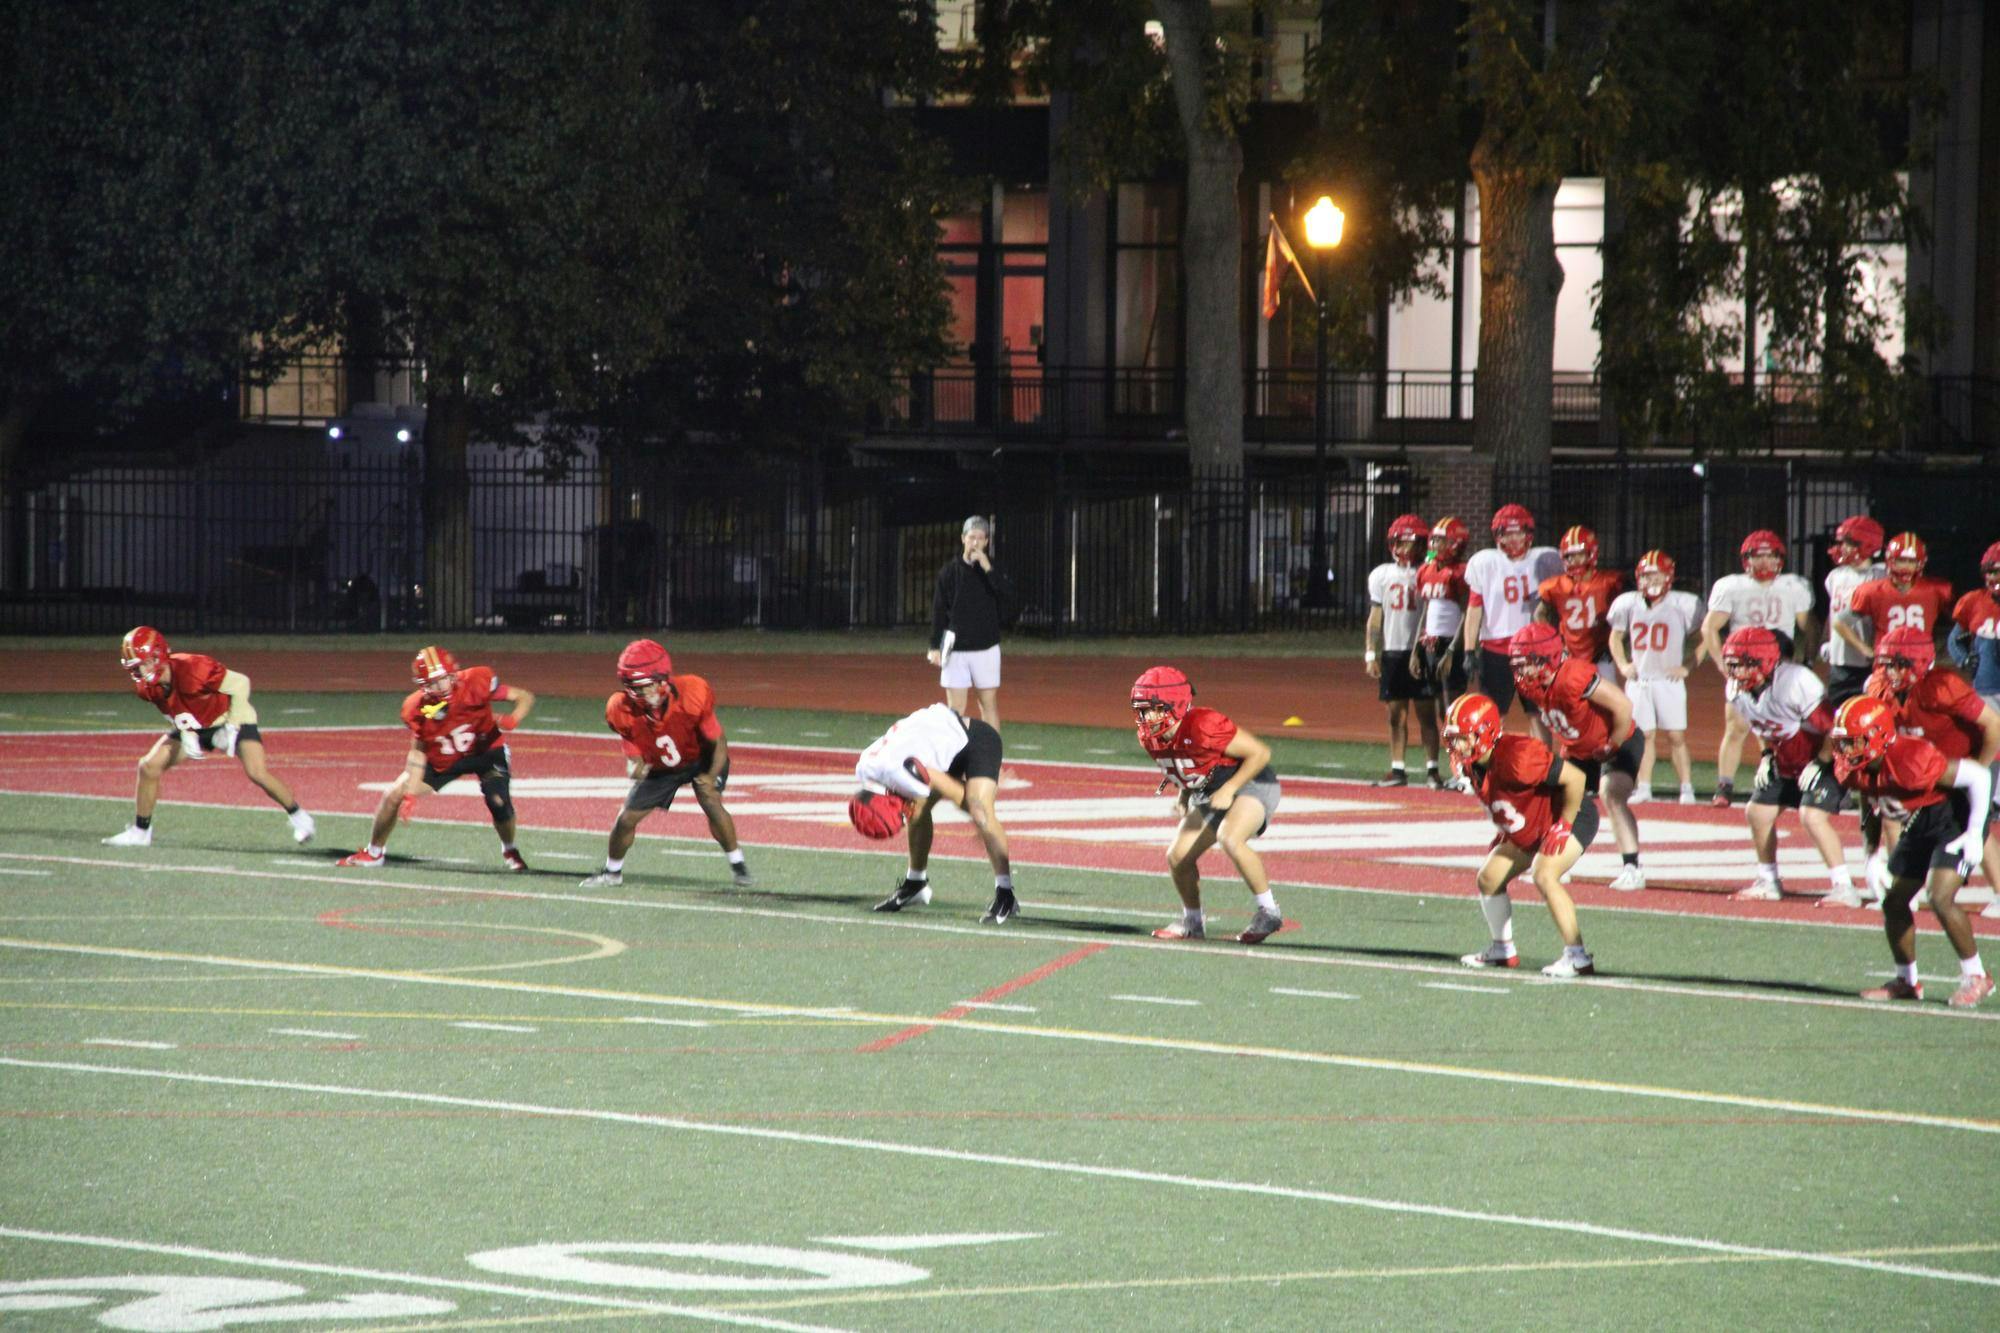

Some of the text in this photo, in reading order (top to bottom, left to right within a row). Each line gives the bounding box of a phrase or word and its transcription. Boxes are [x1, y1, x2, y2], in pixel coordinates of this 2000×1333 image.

[1503, 575, 1531, 604] 61
[1565, 596, 1597, 630] 21
[1887, 604, 1926, 632] 26
[1632, 622, 1669, 651] 20
[434, 723, 476, 755] 16
[655, 734, 682, 767] 3
